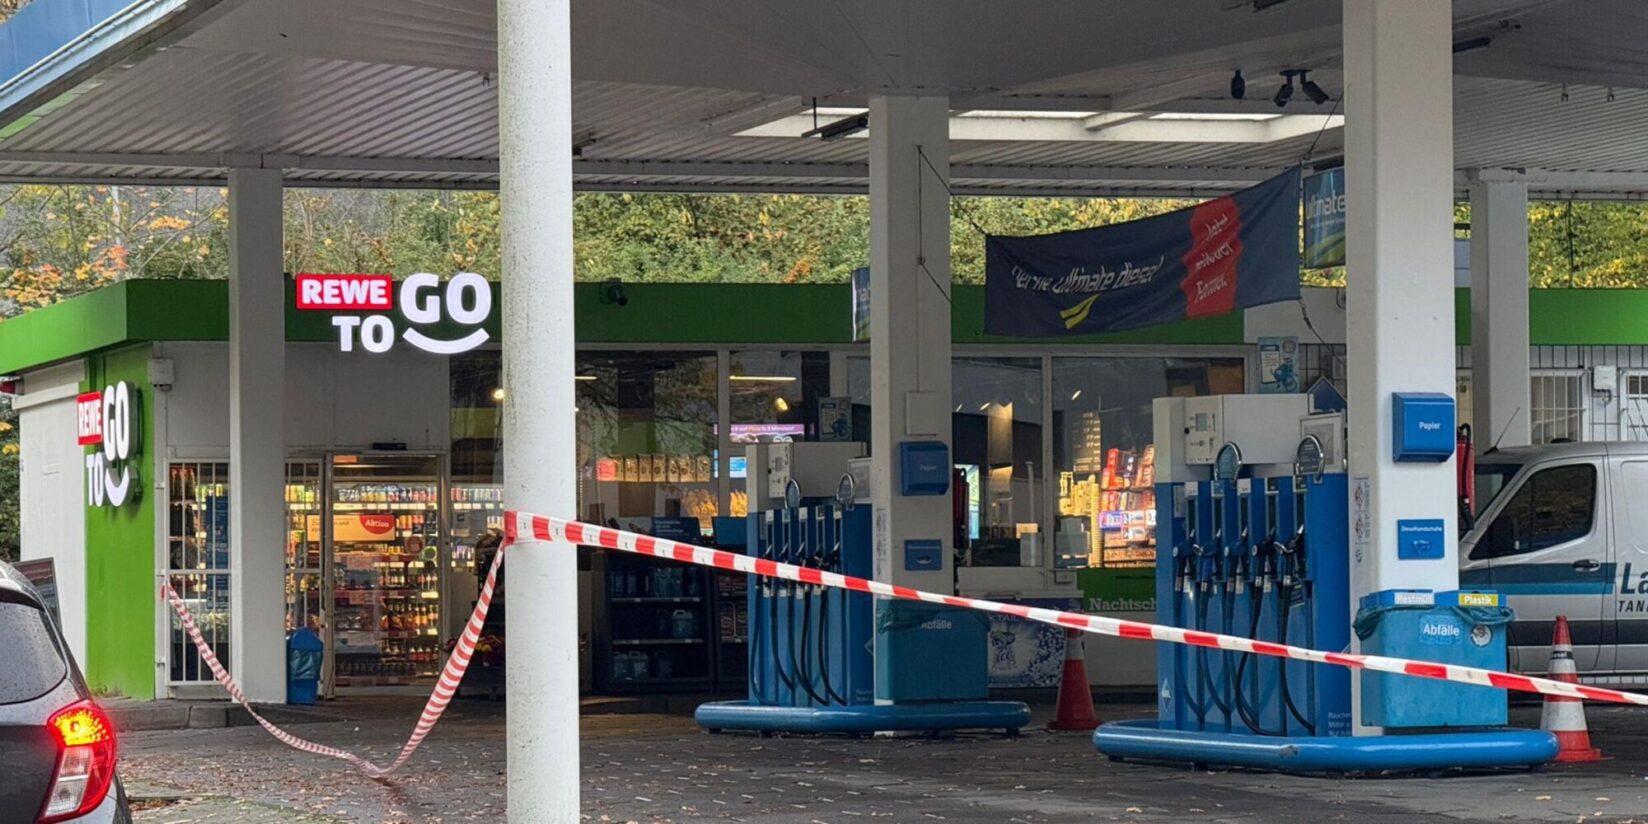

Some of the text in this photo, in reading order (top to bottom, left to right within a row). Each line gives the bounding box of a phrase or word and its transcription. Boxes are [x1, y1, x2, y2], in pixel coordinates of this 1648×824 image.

[1051, 265, 1114, 293] ultimate
[1112, 255, 1164, 289] diesel
[301, 272, 491, 325] REWE GO
[331, 314, 395, 353] TO
[78, 380, 129, 461] REWE GO
[1418, 421, 1441, 432] Papier
[86, 452, 104, 507] TO
[364, 518, 389, 529] Aktion
[1463, 594, 1493, 606] Plastik
[1618, 600, 1648, 612] TAN
[1423, 623, 1461, 637] Abfälle
